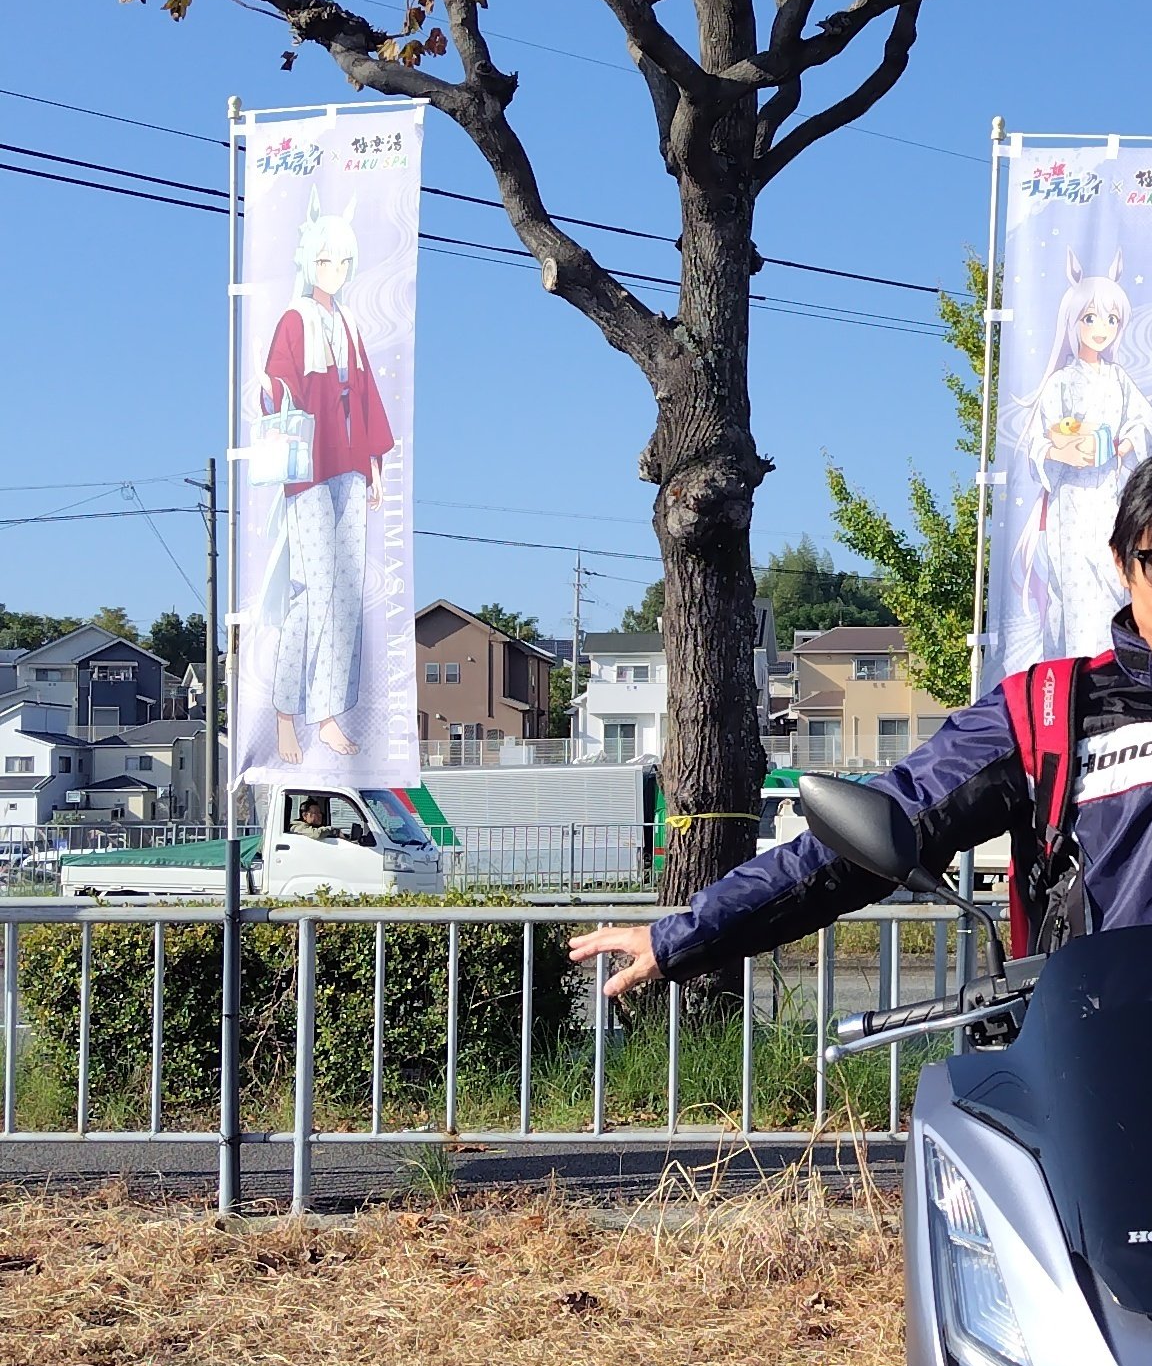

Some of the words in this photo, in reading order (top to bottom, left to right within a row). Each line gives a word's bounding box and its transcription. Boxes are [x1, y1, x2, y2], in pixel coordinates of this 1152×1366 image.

[344, 158, 378, 171] RAKU
[382, 155, 407, 168] SPA
[382, 435, 404, 620] FUJIMASA
[385, 632, 409, 762] MARCH
[1042, 680, 1056, 727] speedo
